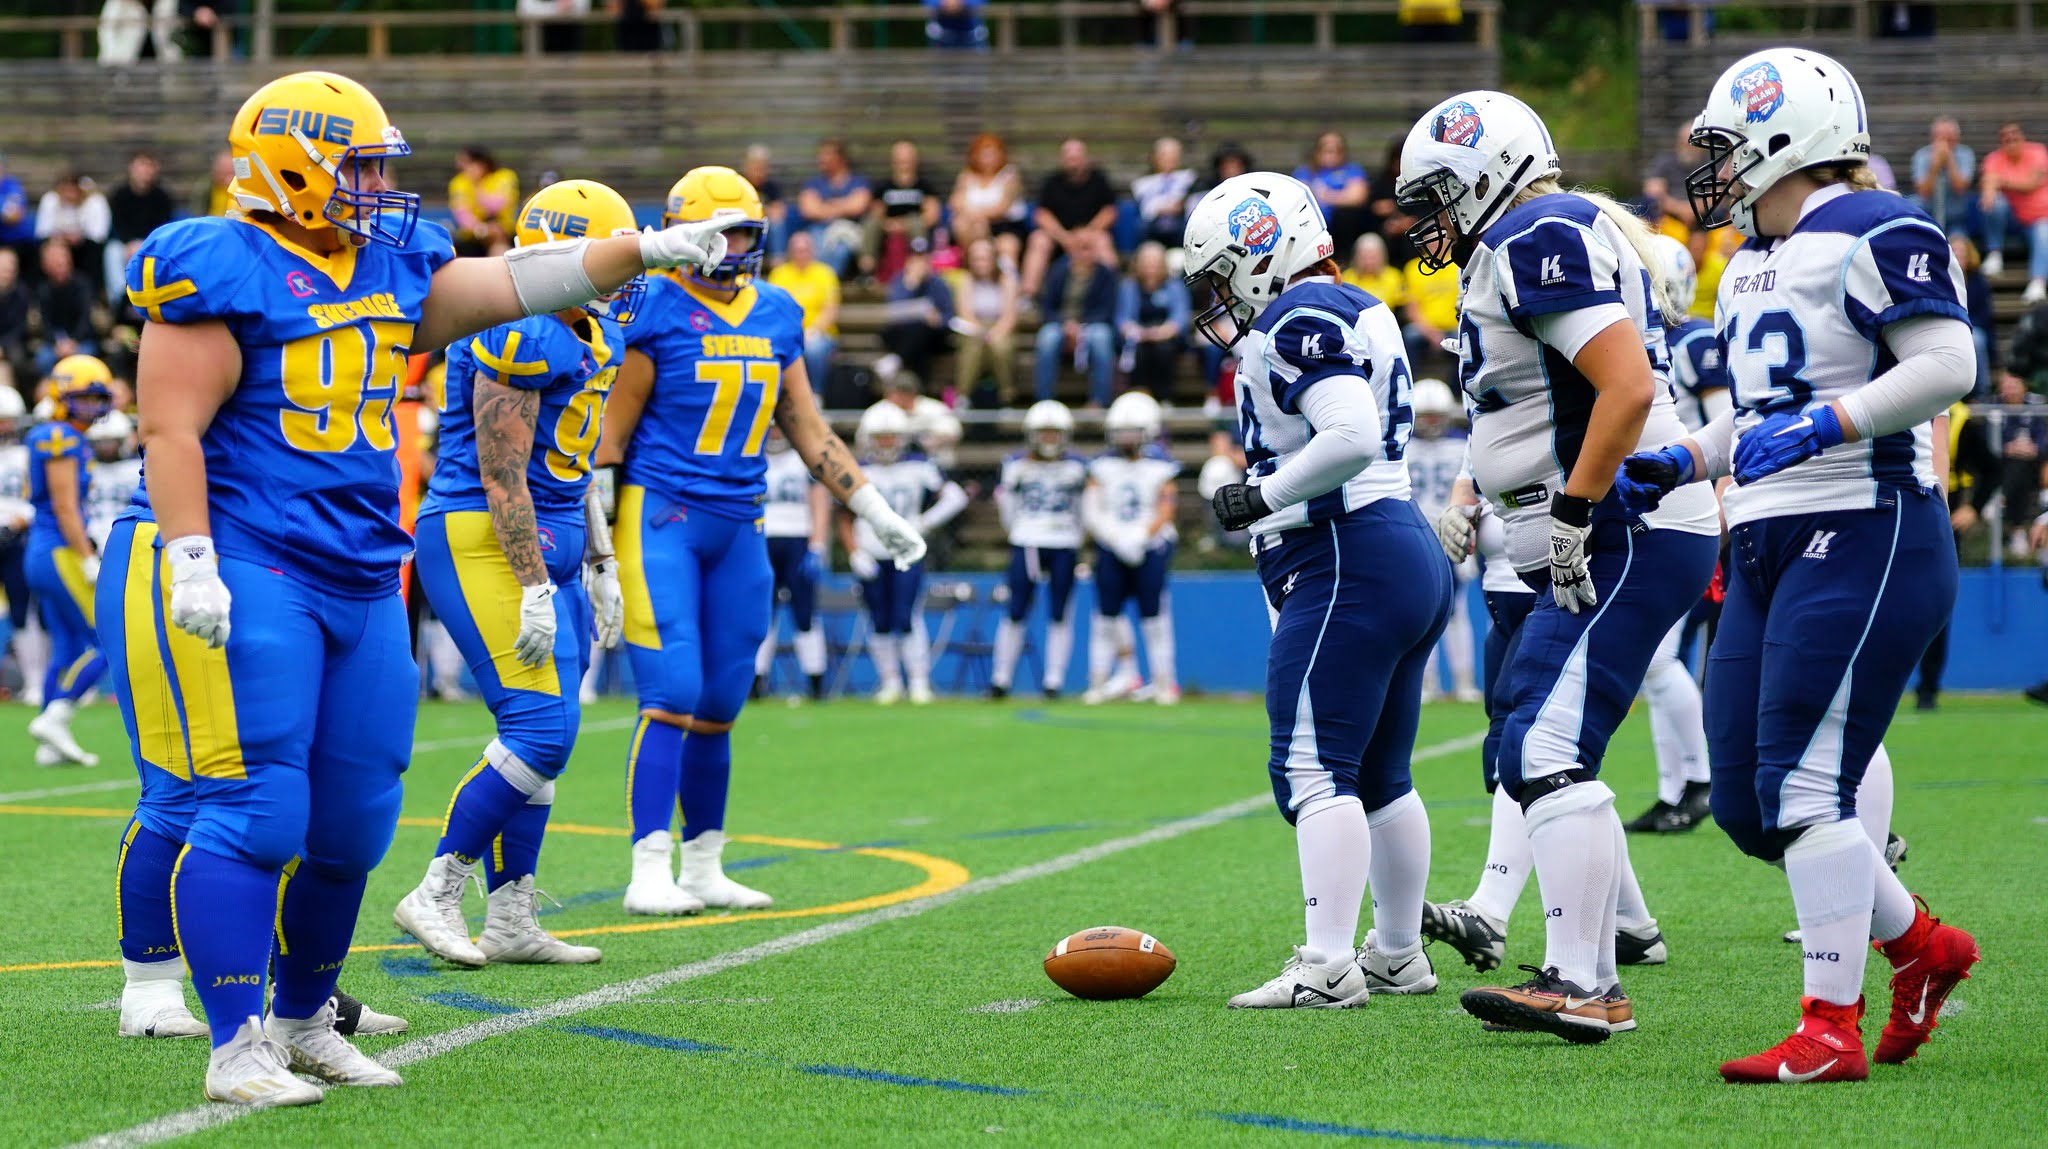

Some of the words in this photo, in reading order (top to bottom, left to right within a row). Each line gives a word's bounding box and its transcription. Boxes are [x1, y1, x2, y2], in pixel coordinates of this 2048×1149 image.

[1748, 86, 1777, 106] INLAND
[258, 108, 354, 146] SWE
[1447, 120, 1475, 143] FINLAND
[524, 208, 590, 238] SWE
[1246, 219, 1275, 243] FINLAND
[308, 292, 407, 328] SVERIGE
[280, 321, 415, 452] 95
[693, 360, 781, 457] 77
[545, 389, 606, 483] 9
[183, 546, 206, 554] adidas
[1551, 535, 1572, 546] adidas
[1544, 907, 1563, 921] KO
[1084, 932, 1122, 942] GST
[212, 974, 260, 988] JAKO
[1821, 1032, 1844, 1048] ALPHA
